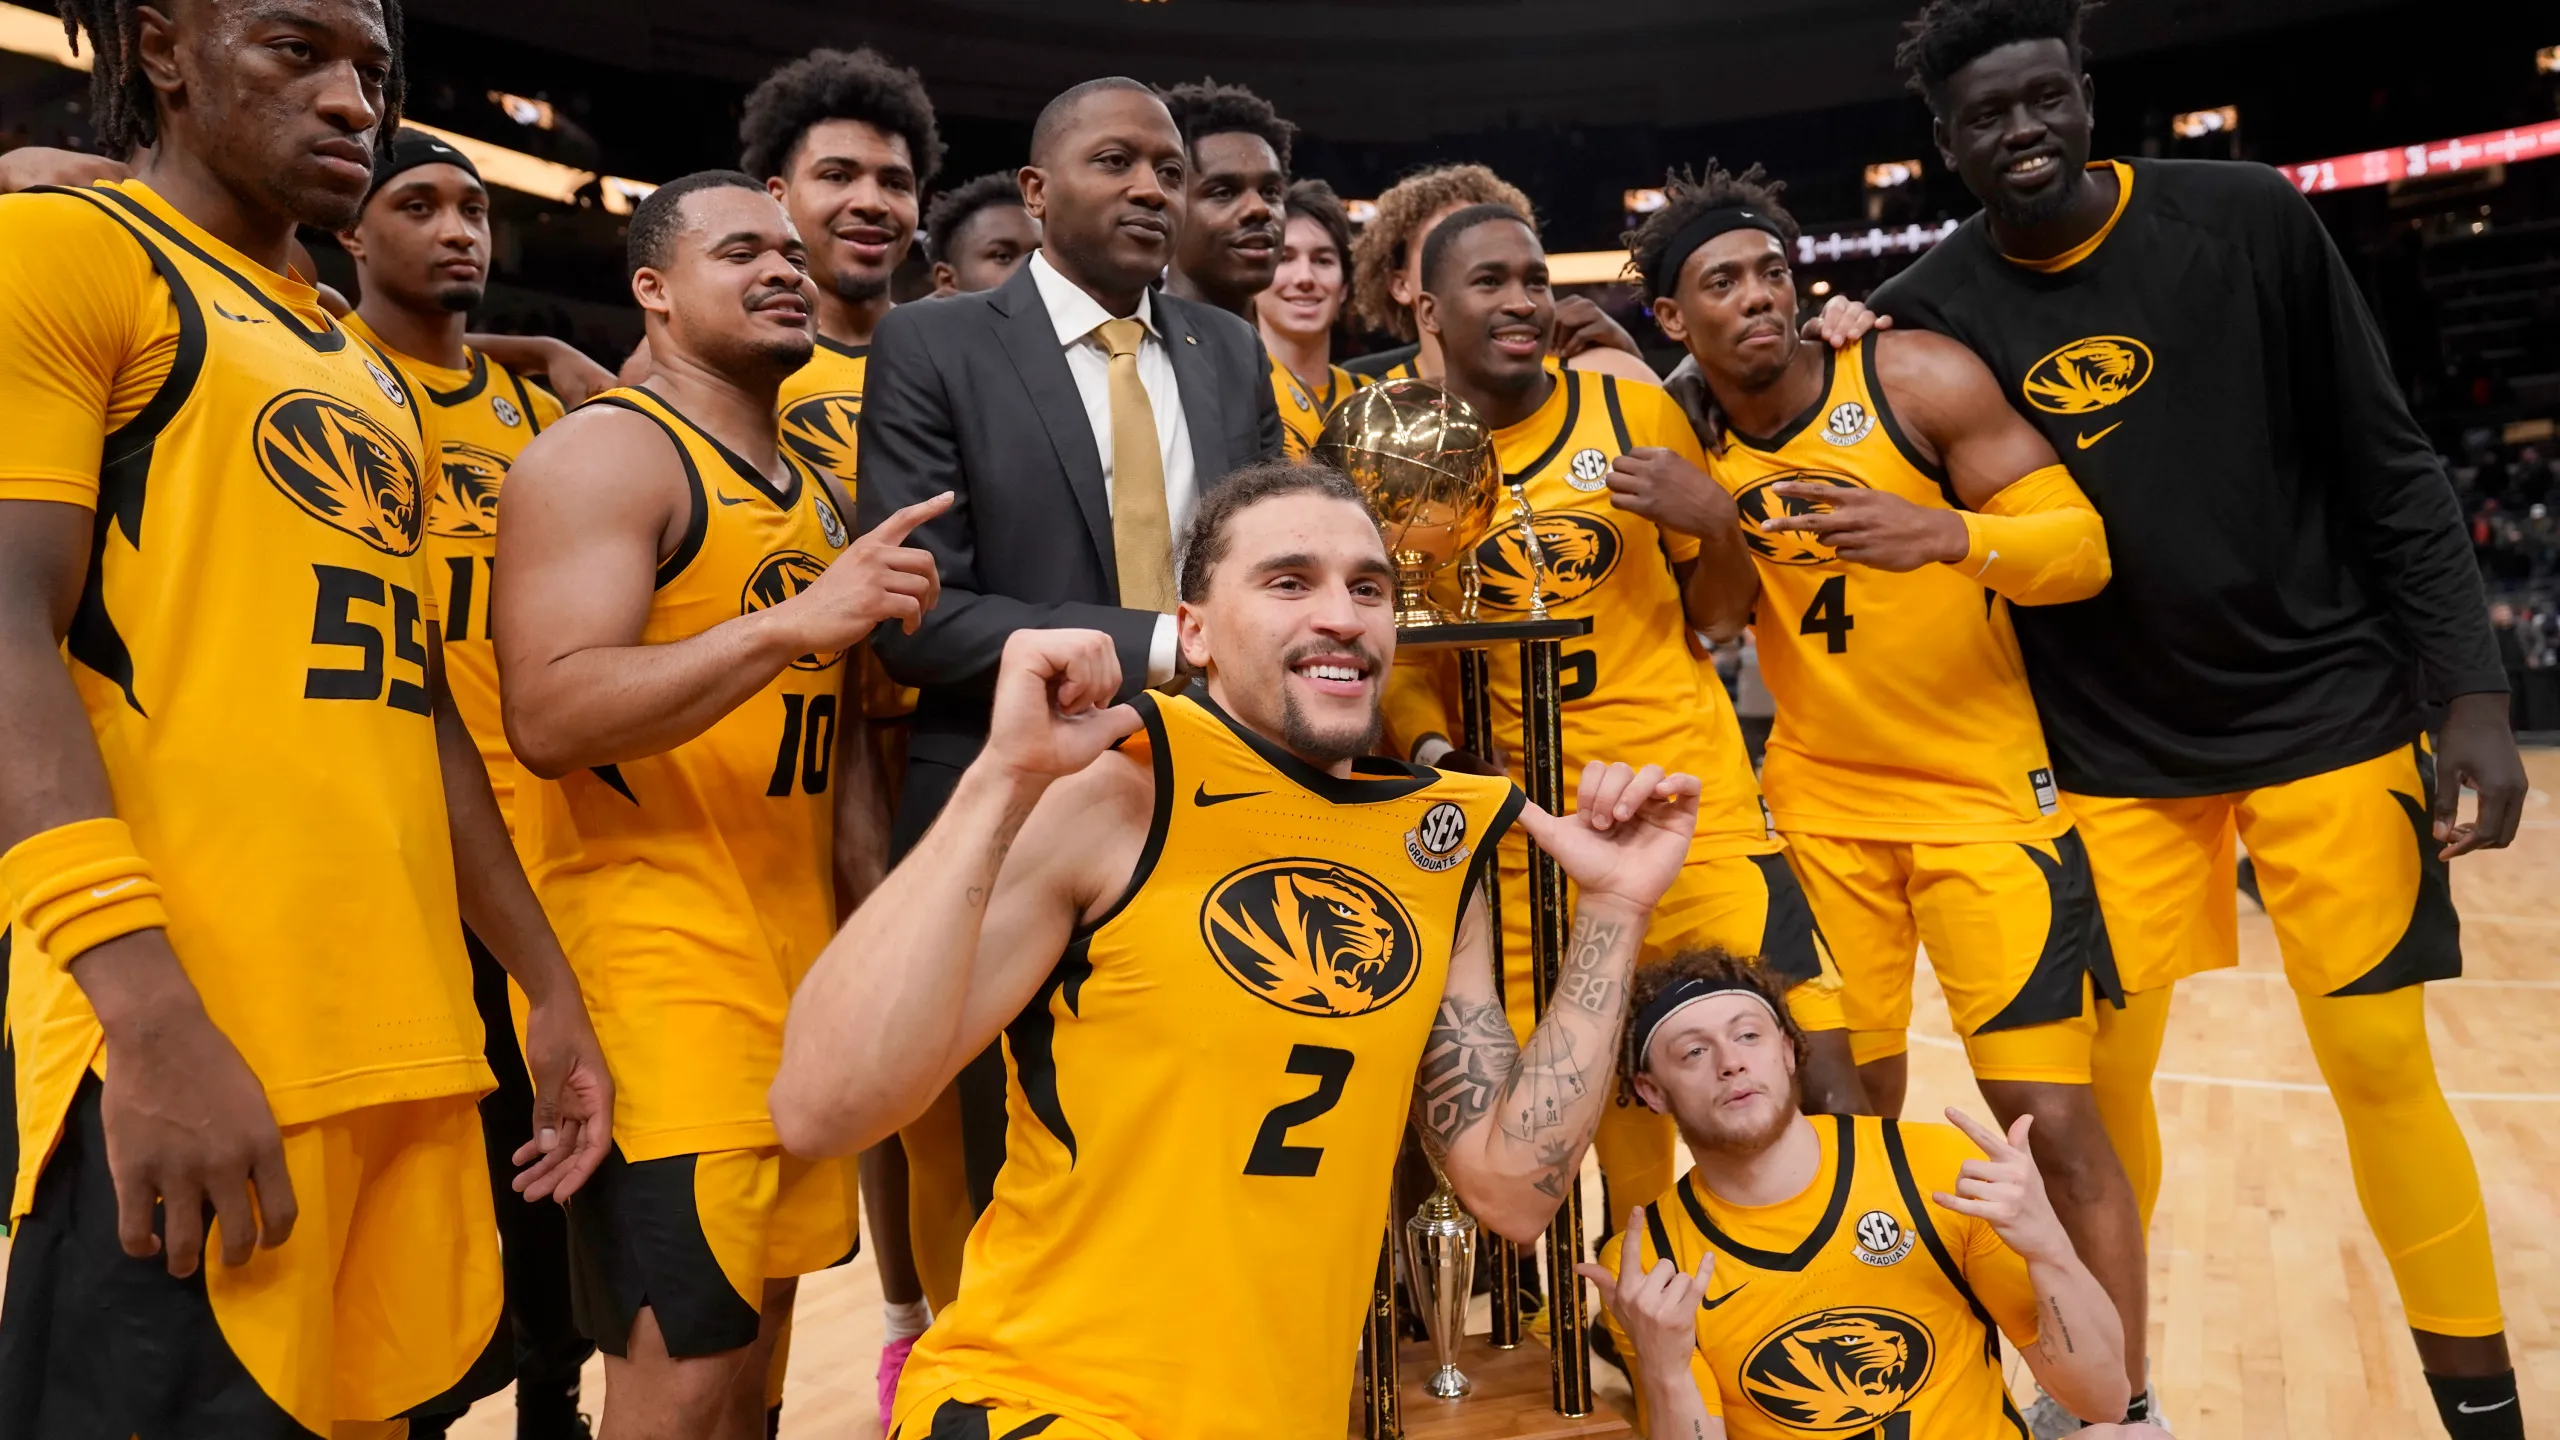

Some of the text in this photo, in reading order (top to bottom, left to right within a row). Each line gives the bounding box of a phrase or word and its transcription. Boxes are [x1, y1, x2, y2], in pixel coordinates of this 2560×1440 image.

[1827, 425, 1869, 446] GRADUATE
[1829, 403, 1865, 435] SEC
[1571, 449, 1607, 480] SEC
[1800, 574, 1854, 654] 4
[304, 563, 433, 718] 55
[766, 693, 836, 796] 10
[1421, 804, 1465, 853] SEC
[1408, 842, 1457, 870] GRADUATE
[1242, 1043, 1355, 1177] 2
[1857, 1211, 1899, 1251] SEC
[1862, 1240, 1911, 1266] GRADUATE
